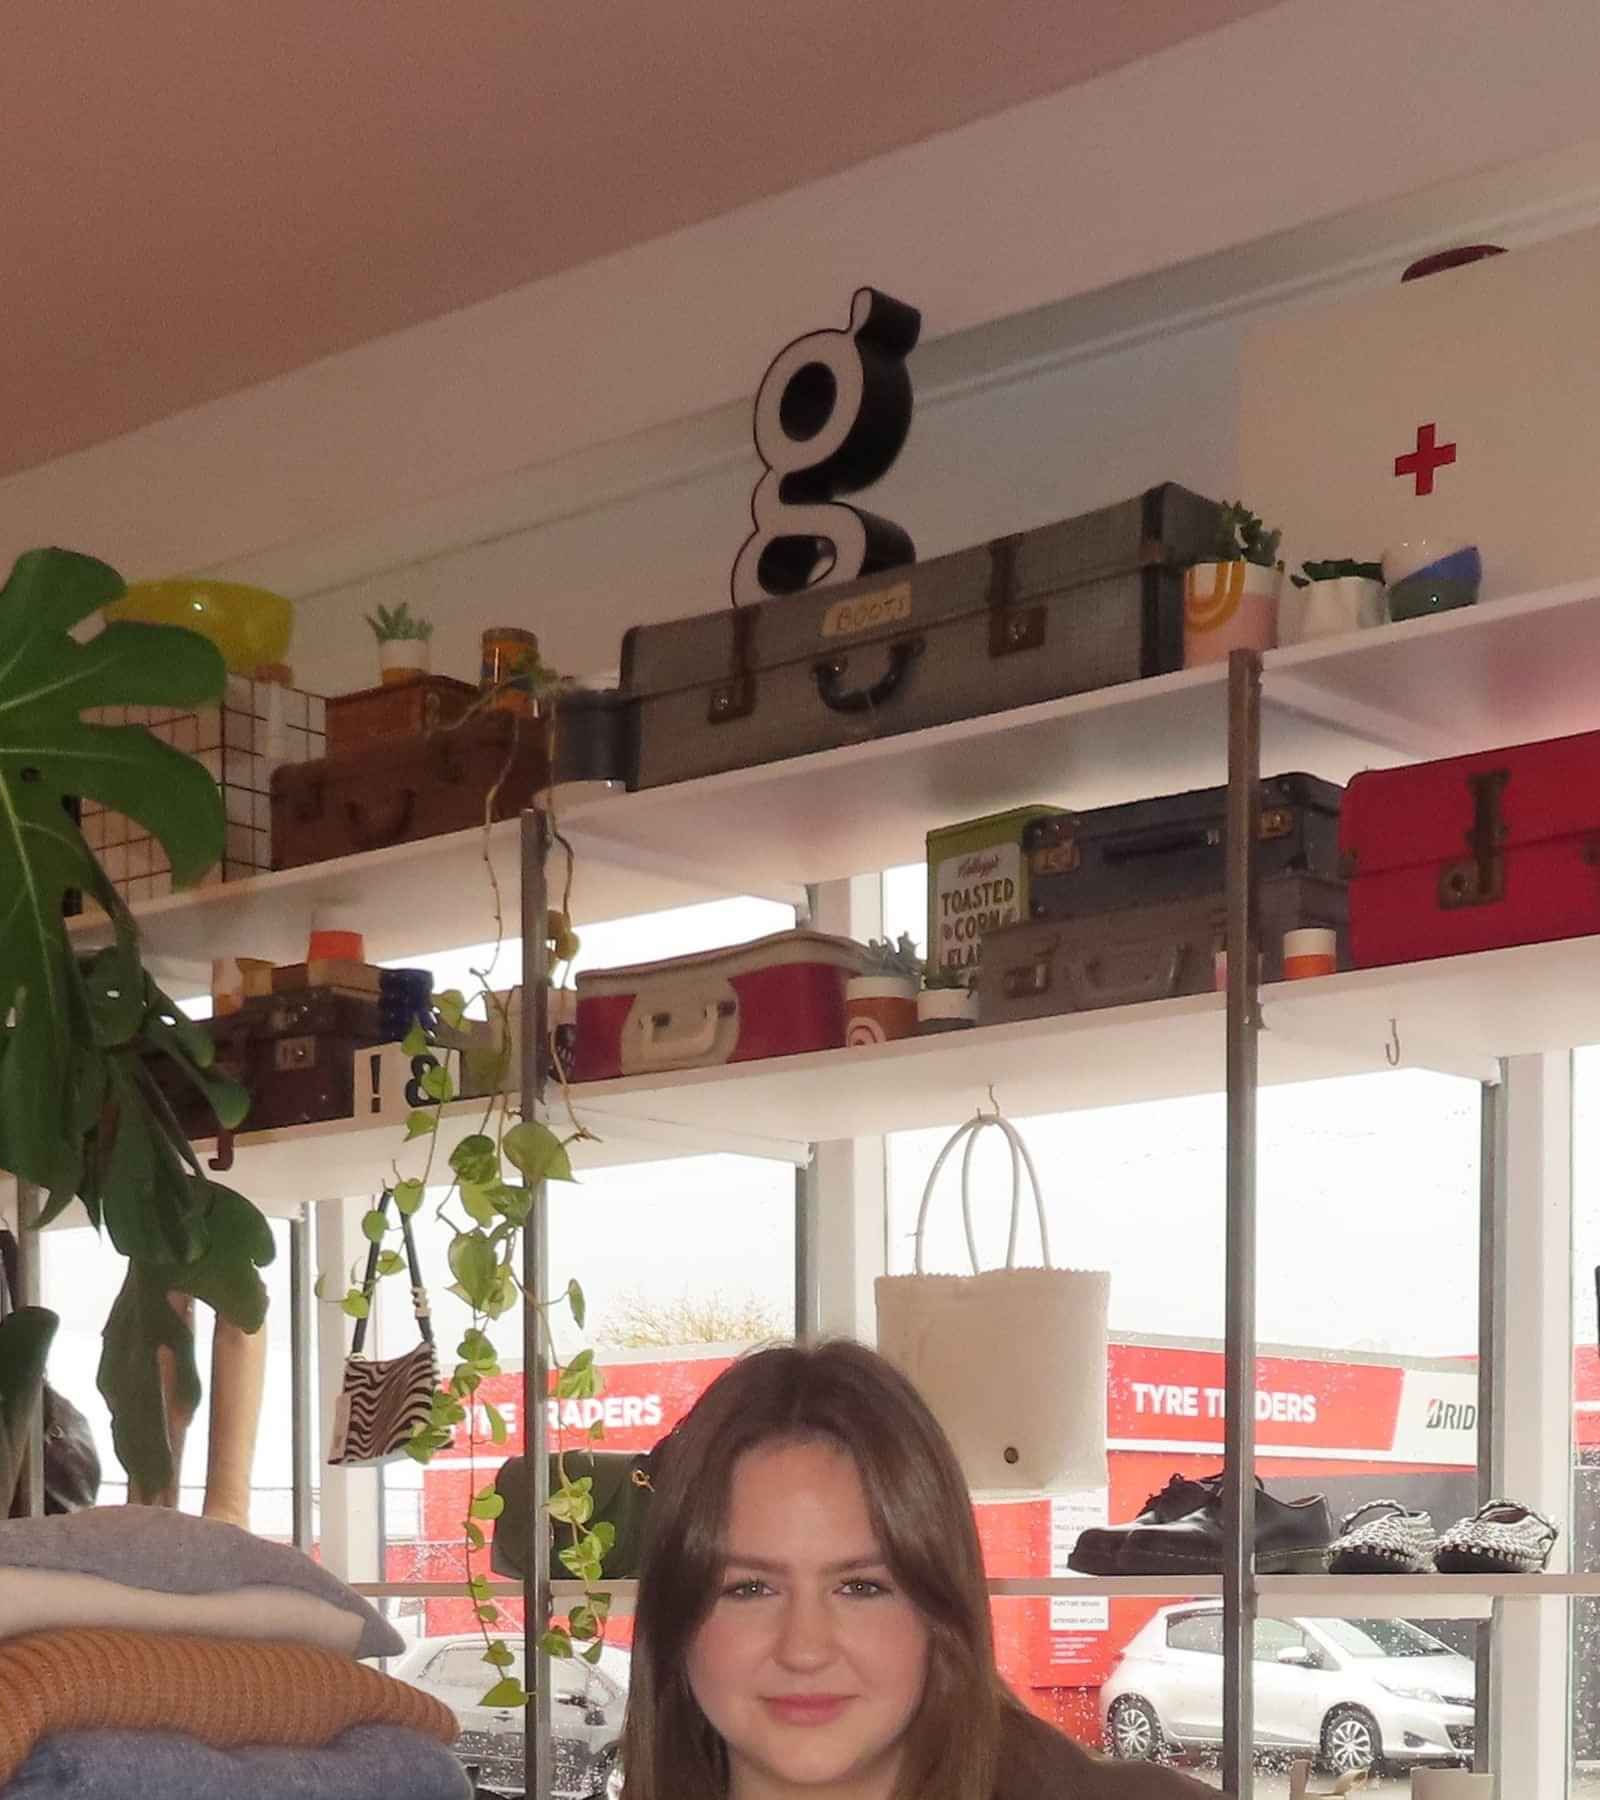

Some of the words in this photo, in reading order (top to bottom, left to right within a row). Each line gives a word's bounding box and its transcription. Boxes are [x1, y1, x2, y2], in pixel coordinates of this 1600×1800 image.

[941, 878, 1014, 916] TOASTED
[545, 1394, 661, 1430] RADERS
[1132, 1383, 1198, 1417] TYRE
[1205, 1388, 1317, 1424] TDERS
